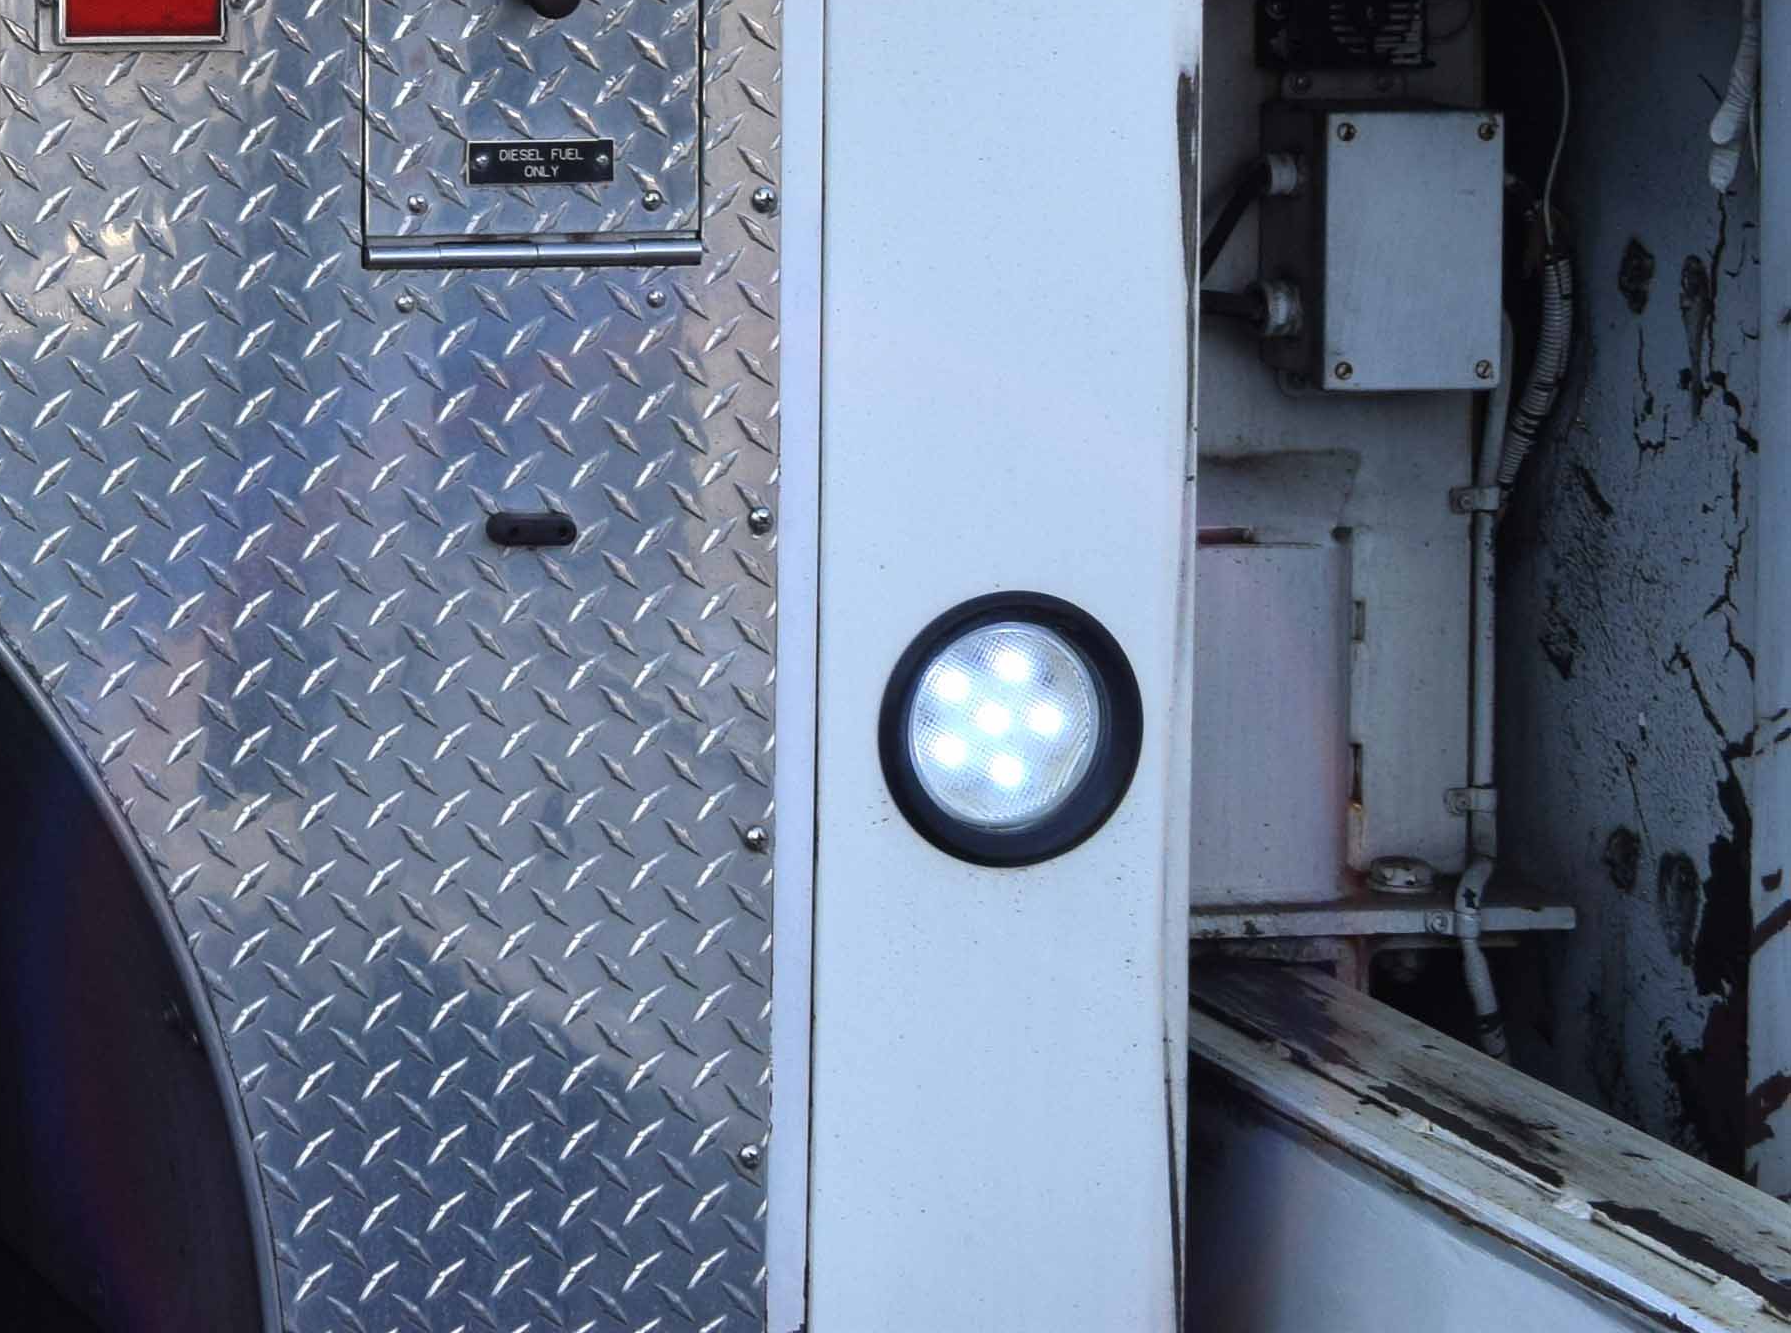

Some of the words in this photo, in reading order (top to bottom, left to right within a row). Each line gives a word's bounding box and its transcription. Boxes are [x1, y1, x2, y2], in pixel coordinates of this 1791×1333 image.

[499, 149, 544, 161] DIESEL
[550, 148, 584, 160] FUEL
[524, 165, 559, 177] ONLY
